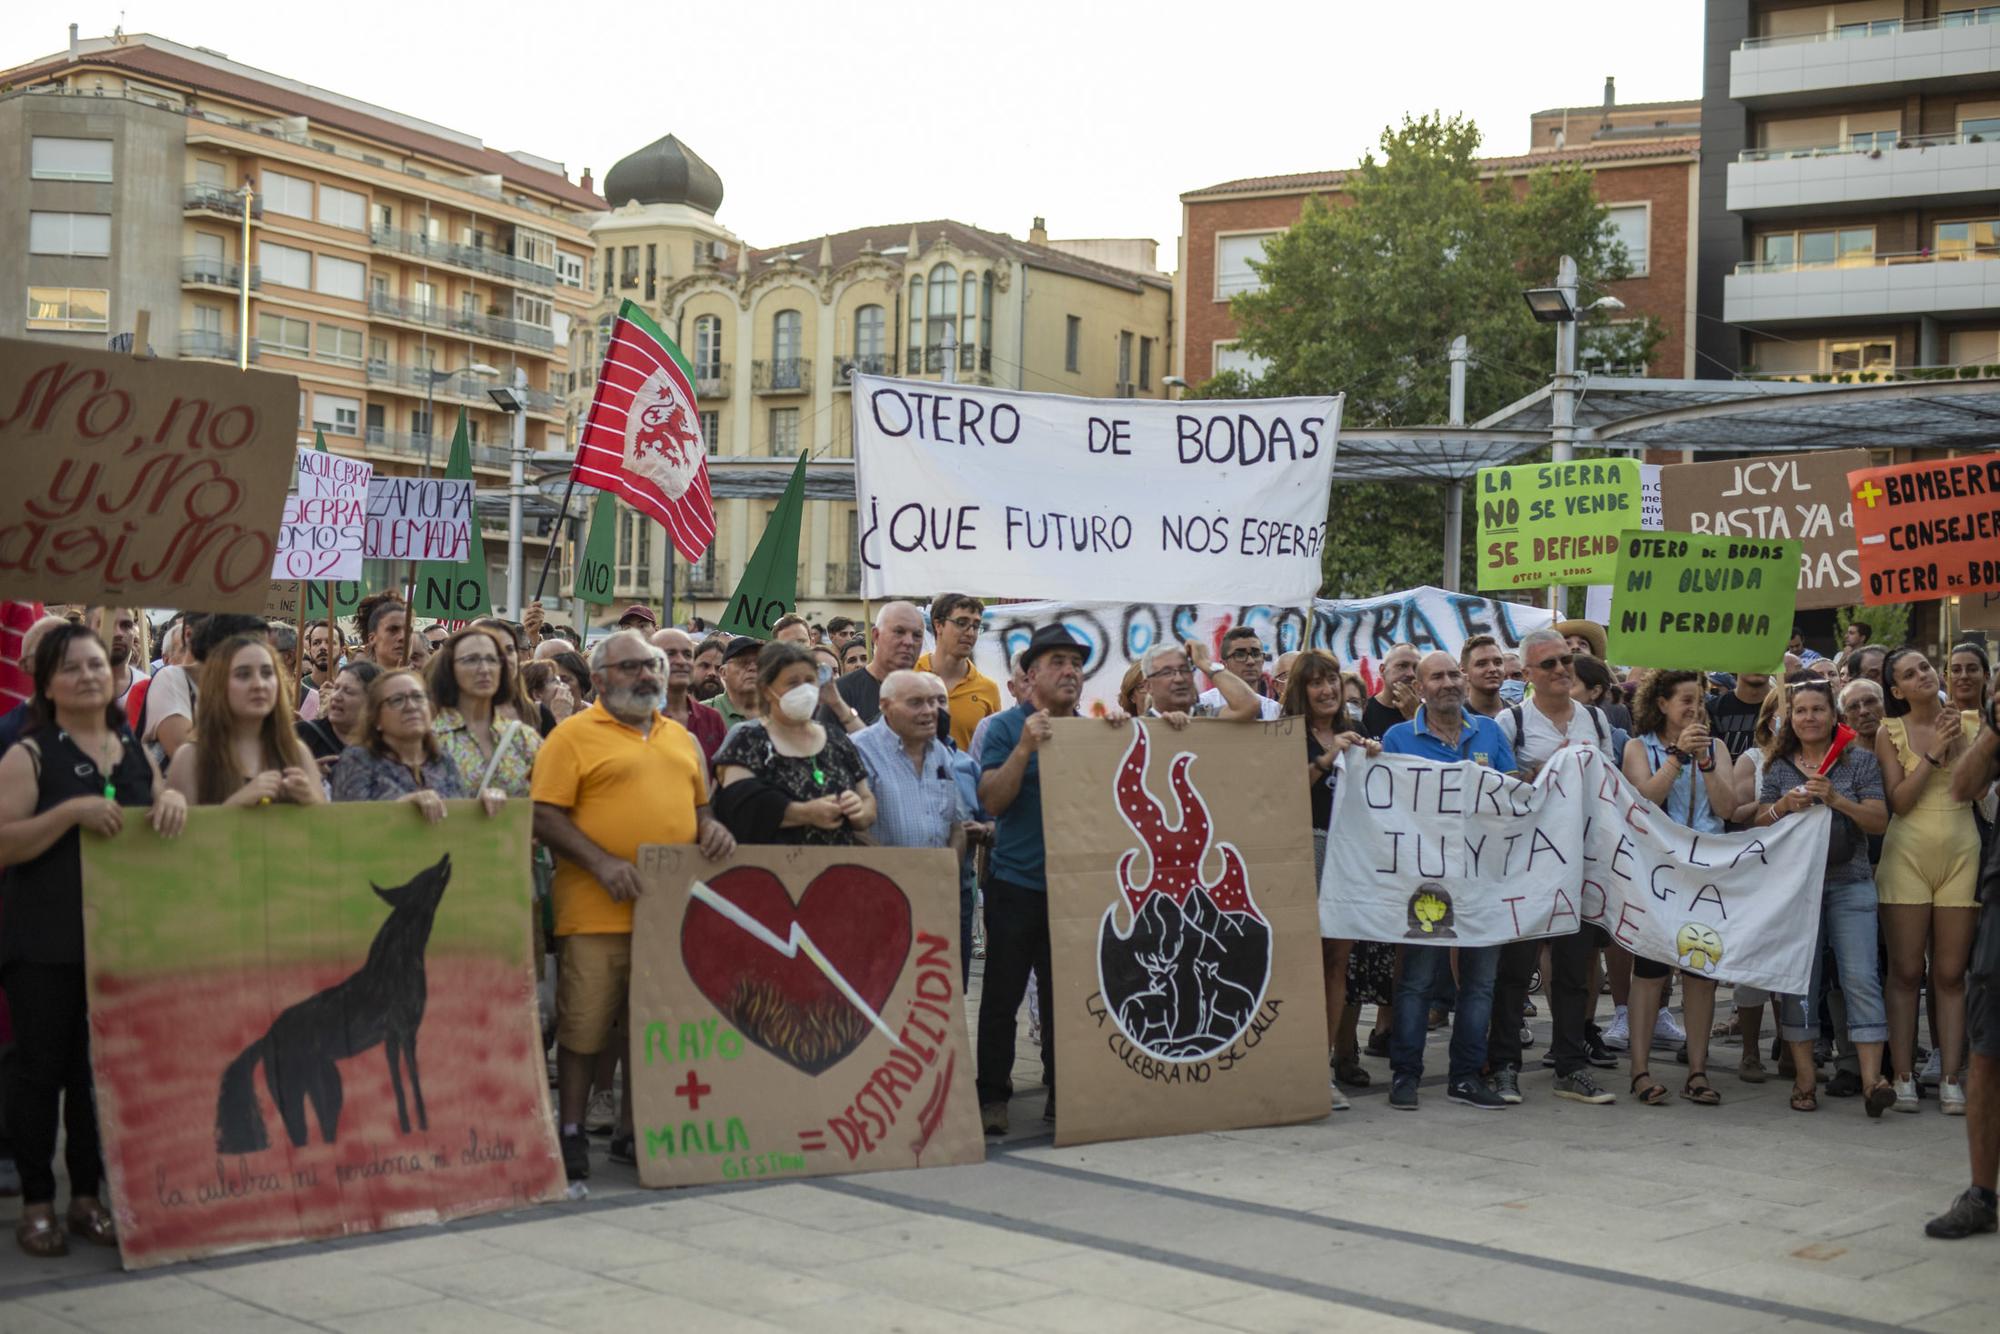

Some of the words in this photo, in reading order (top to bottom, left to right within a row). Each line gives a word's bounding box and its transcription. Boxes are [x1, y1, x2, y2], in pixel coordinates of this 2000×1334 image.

[154, 396, 255, 450] no
[871, 388, 1020, 446] OTERO
[1088, 416, 1132, 455] DE
[1177, 414, 1325, 466] BODAS
[24, 457, 100, 520] y
[1484, 470, 1511, 493] LA
[1538, 465, 1621, 489] SIERRA
[1721, 461, 1811, 497] JCYL
[1885, 460, 2000, 506] BOMBERO
[367, 478, 474, 518] ZAMORA
[1484, 498, 1520, 529] NO
[1529, 499, 1556, 521] SE
[1565, 493, 1629, 516] VENDE
[277, 525, 364, 551] OMOS
[363, 518, 471, 559] QUEMADA
[860, 495, 980, 570] ¿QUE
[1006, 506, 1132, 553] FUTURO
[1162, 515, 1230, 553] NOS
[1690, 506, 1791, 539] BASTA
[1795, 504, 1835, 538] YA
[1839, 502, 1855, 528] d
[1889, 509, 2000, 551] CONSEJER
[1488, 541, 1519, 568] SE
[1533, 535, 1619, 562] DEFIEND
[1629, 539, 1688, 559] OTERO
[1728, 544, 1783, 560] BODAS
[307, 579, 359, 610] NO
[426, 577, 481, 611] NO
[583, 558, 609, 595] NO
[1627, 570, 1652, 592] NI
[1678, 567, 1762, 593] OLVIDA
[1870, 563, 1938, 596] OTERO
[1948, 574, 1965, 586] DE
[734, 594, 786, 631] NO
[1452, 597, 1523, 652] EL
[1621, 610, 1647, 633] NI
[1659, 611, 1770, 636] PERDONA
[644, 1015, 745, 1066] RAYO
[1086, 991, 1107, 1028] LA
[1108, 1033, 1181, 1084] CULEBRA
[1187, 1062, 1211, 1083] NO
[1218, 1044, 1246, 1071] SE
[1244, 999, 1283, 1048] CALLA
[644, 1116, 750, 1160] MALA
